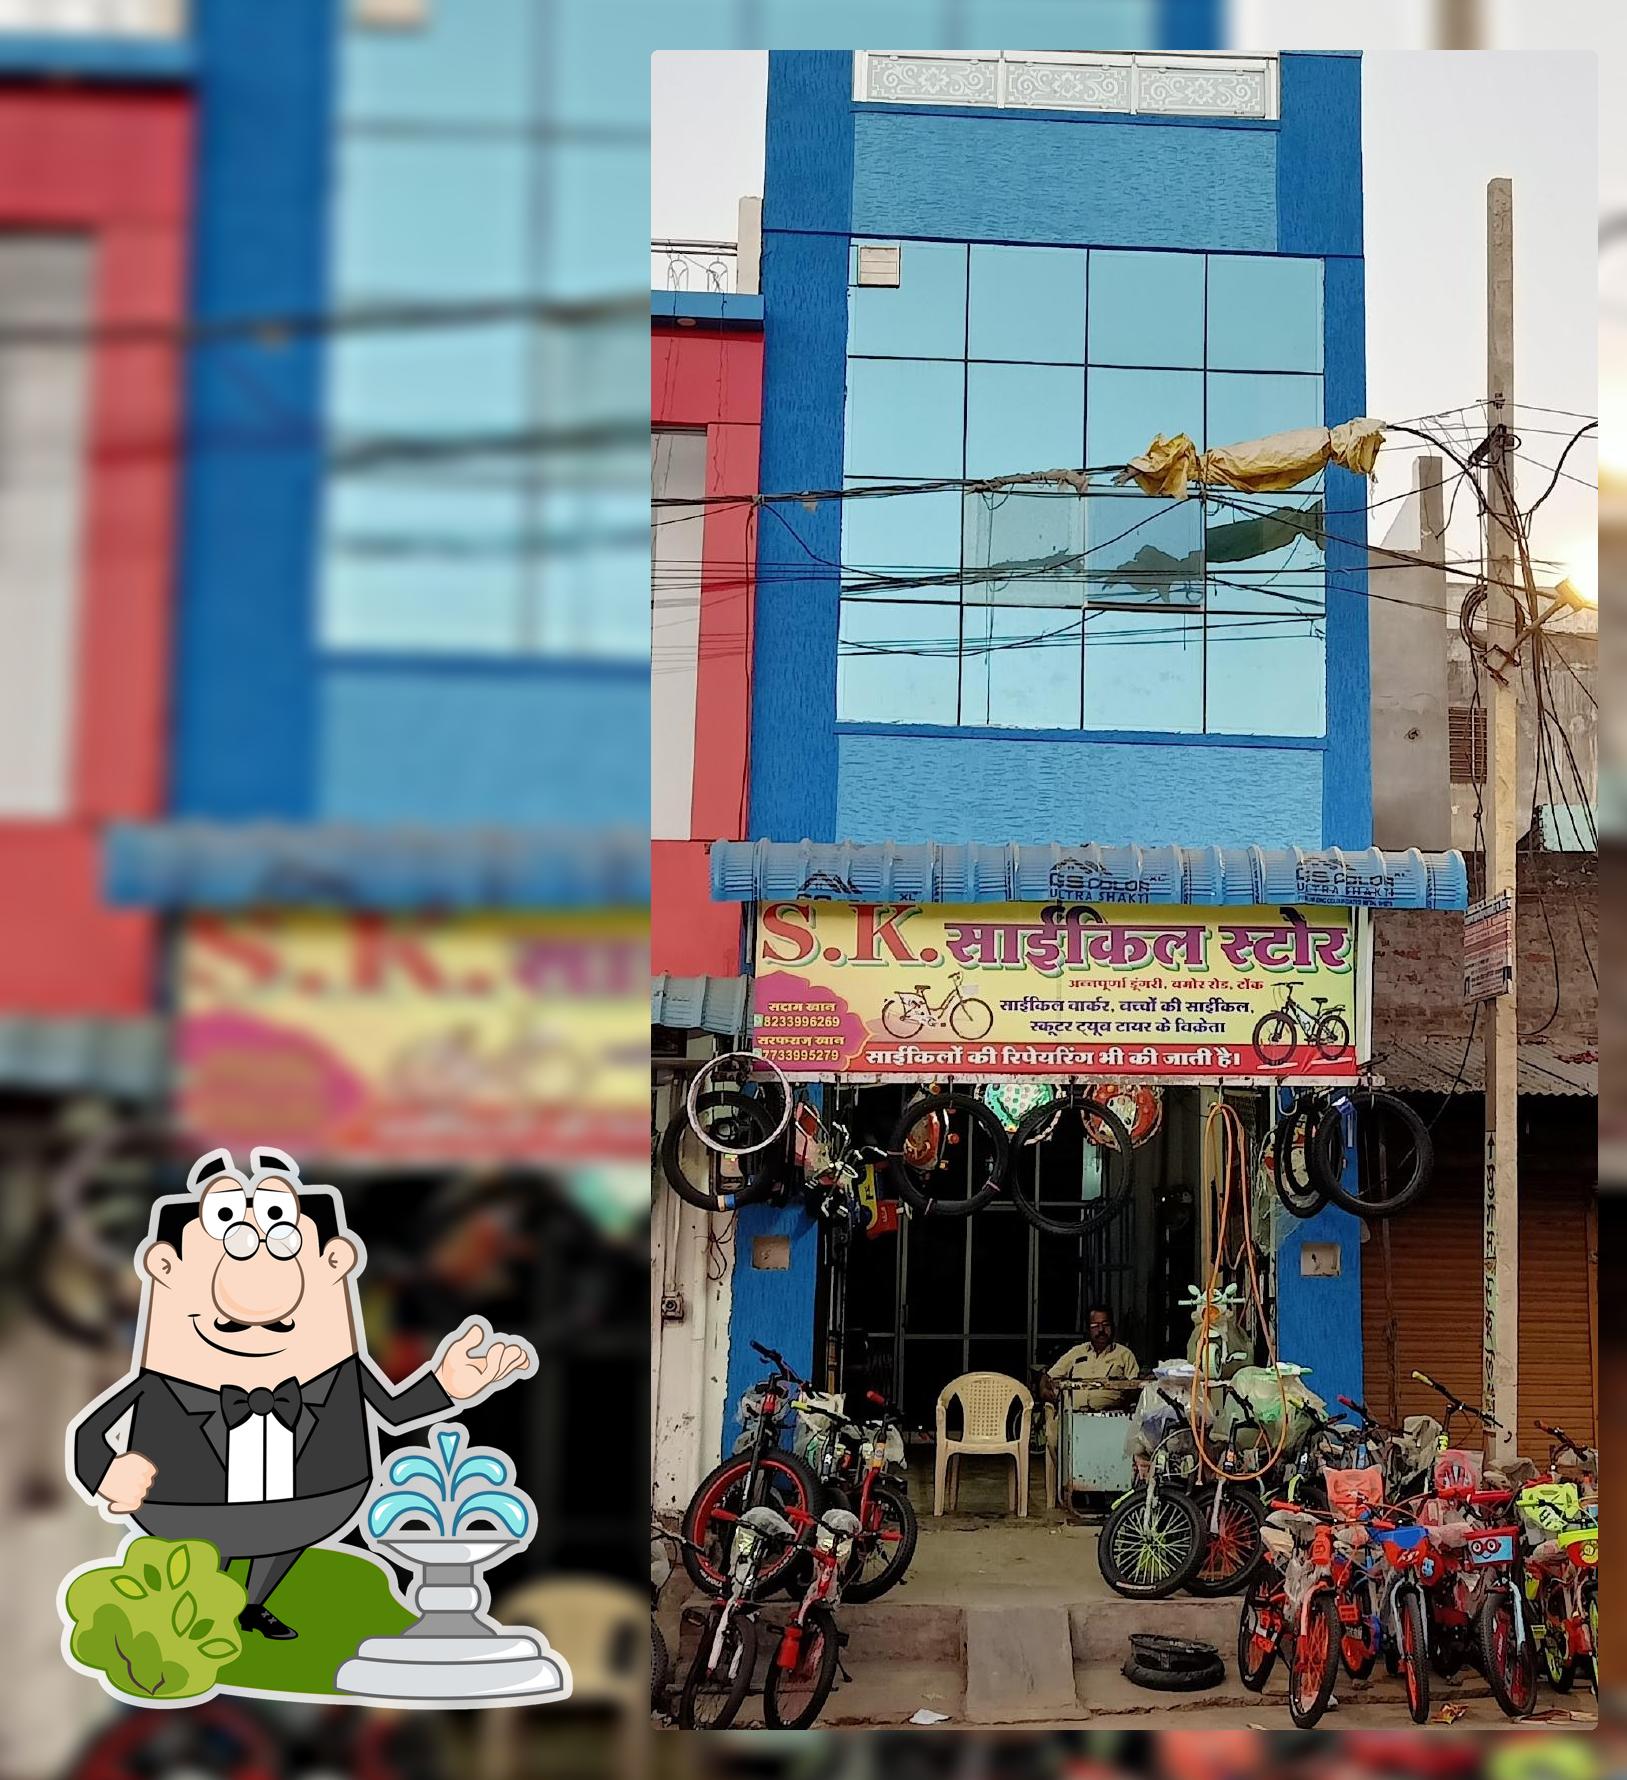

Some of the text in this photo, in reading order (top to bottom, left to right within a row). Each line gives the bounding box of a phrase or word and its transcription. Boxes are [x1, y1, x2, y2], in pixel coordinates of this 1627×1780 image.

[1049, 889, 1150, 904] ULTRA SHAKTI
[762, 902, 1351, 973] S.K. साईकिल स्टोर
[1236, 977, 1264, 990] टोंक
[805, 1002, 837, 1013] खान
[999, 995, 1064, 1013] साईकिल
[1160, 996, 1182, 1012] की
[1030, 1020, 1073, 1036] स्कूटर
[1115, 1021, 1152, 1033] टायर
[1155, 1017, 1171, 1032] के
[1175, 1017, 1226, 1034] विक्रेता
[814, 1035, 845, 1046] खान
[866, 1045, 964, 1067] साईकिलों
[967, 1045, 998, 1065] की
[1001, 1045, 1095, 1066] रिपेयरिंग
[1098, 1046, 1125, 1066] भी
[1128, 1046, 1159, 1066] की
[1162, 1046, 1214, 1066] जाती
